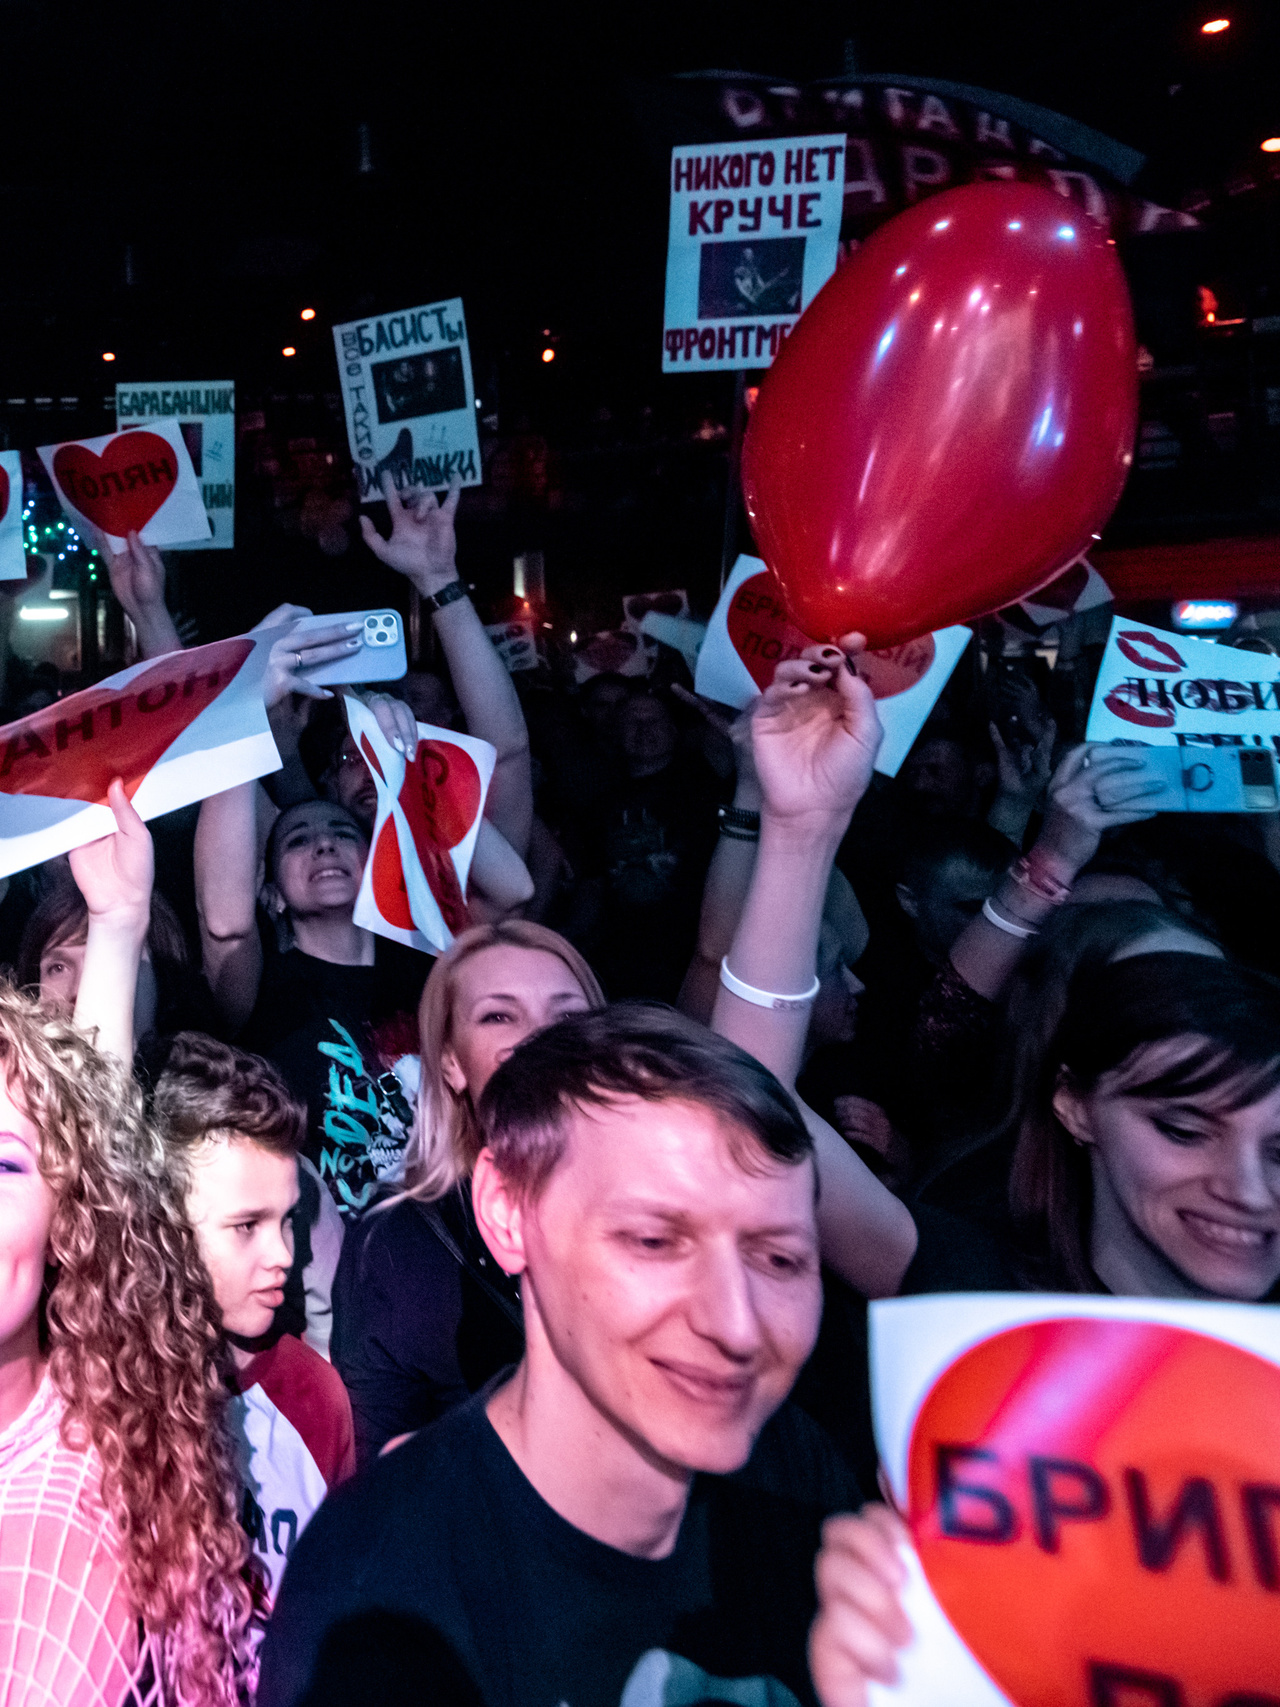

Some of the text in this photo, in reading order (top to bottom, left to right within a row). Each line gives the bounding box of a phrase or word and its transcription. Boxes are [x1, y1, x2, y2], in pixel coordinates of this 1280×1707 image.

[675, 145, 844, 192] НИКОГО НЕТ
[689, 193, 822, 236] КРУЧЕ
[61, 458, 174, 500] Толян
